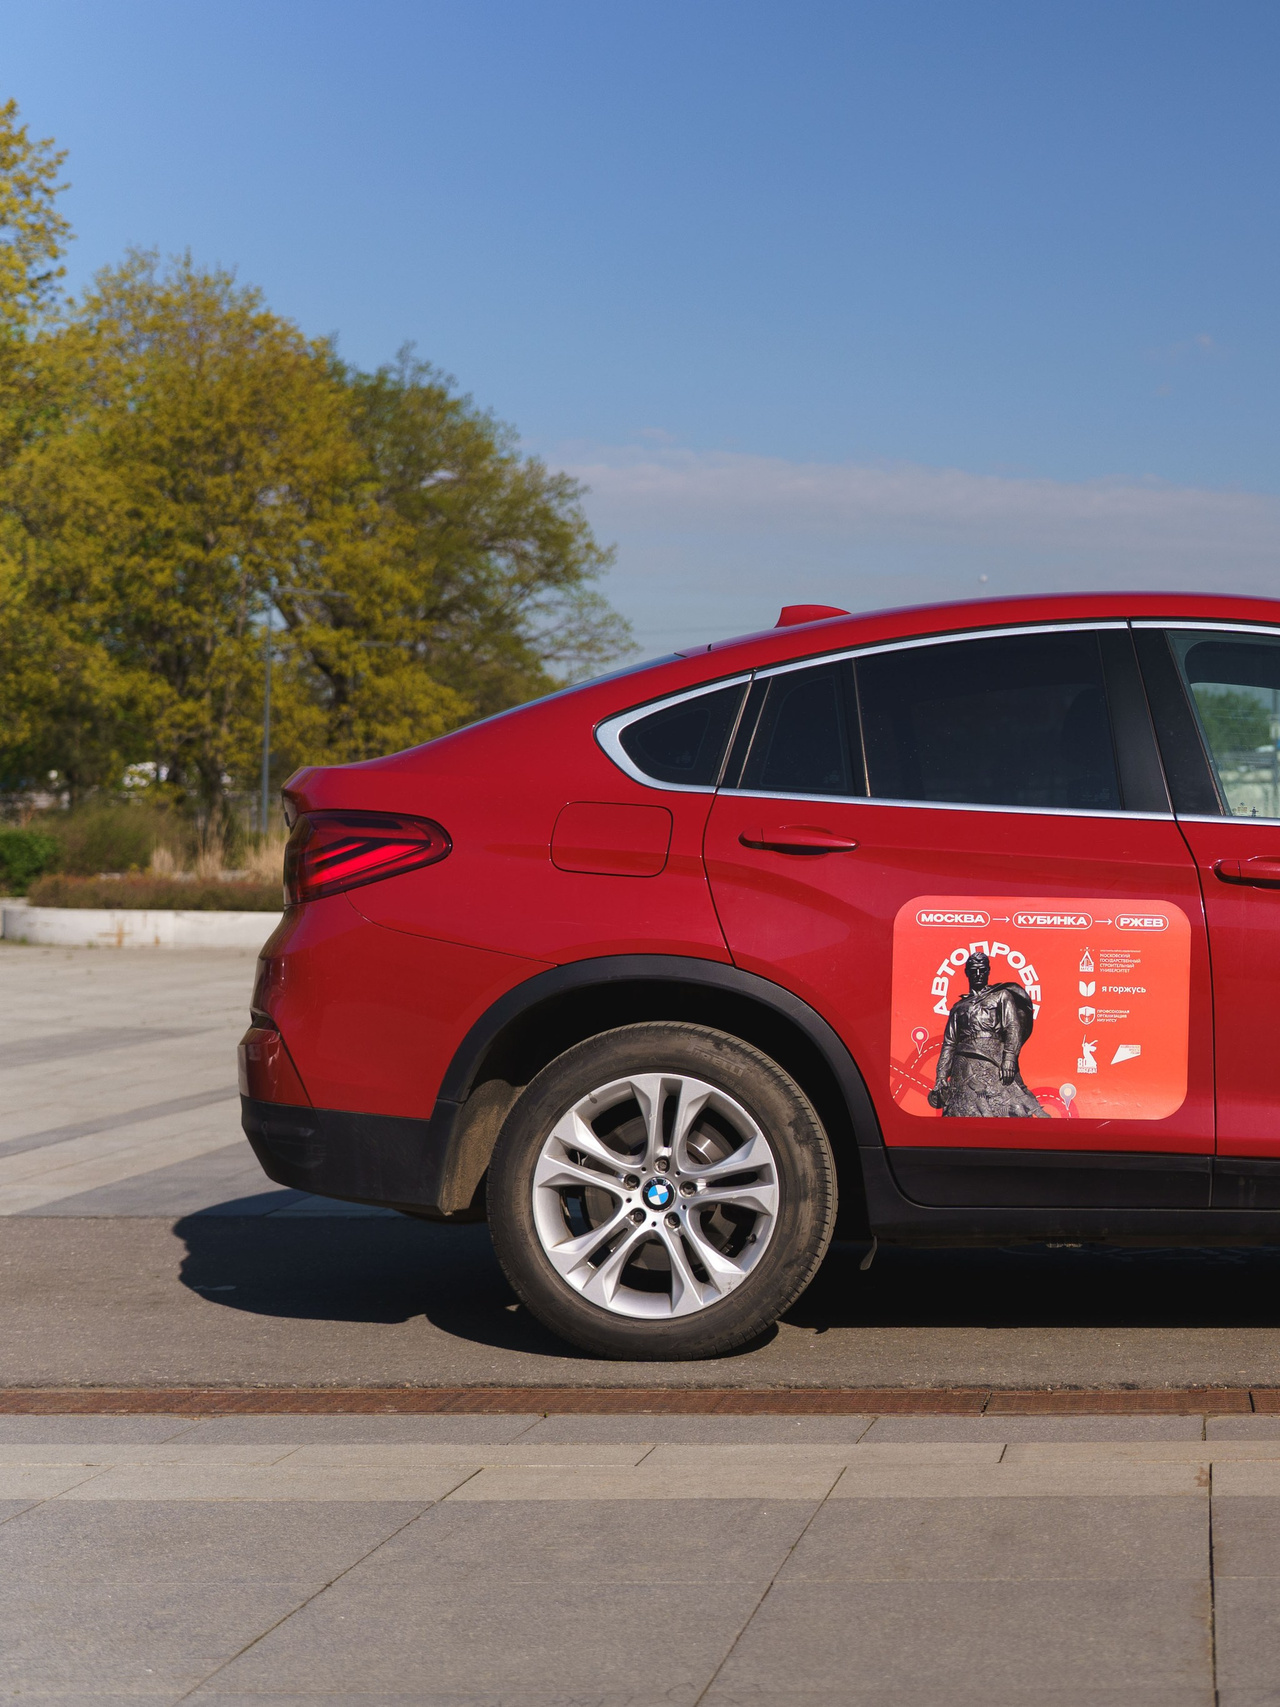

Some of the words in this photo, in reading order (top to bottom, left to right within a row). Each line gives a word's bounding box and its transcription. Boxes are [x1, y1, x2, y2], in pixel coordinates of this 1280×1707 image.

[920, 913, 985, 924] МОСКВА
[1017, 915, 1088, 926] КУБИНКА
[1119, 917, 1164, 928] РЖЕВ
[1108, 986, 1147, 994] горжусь
